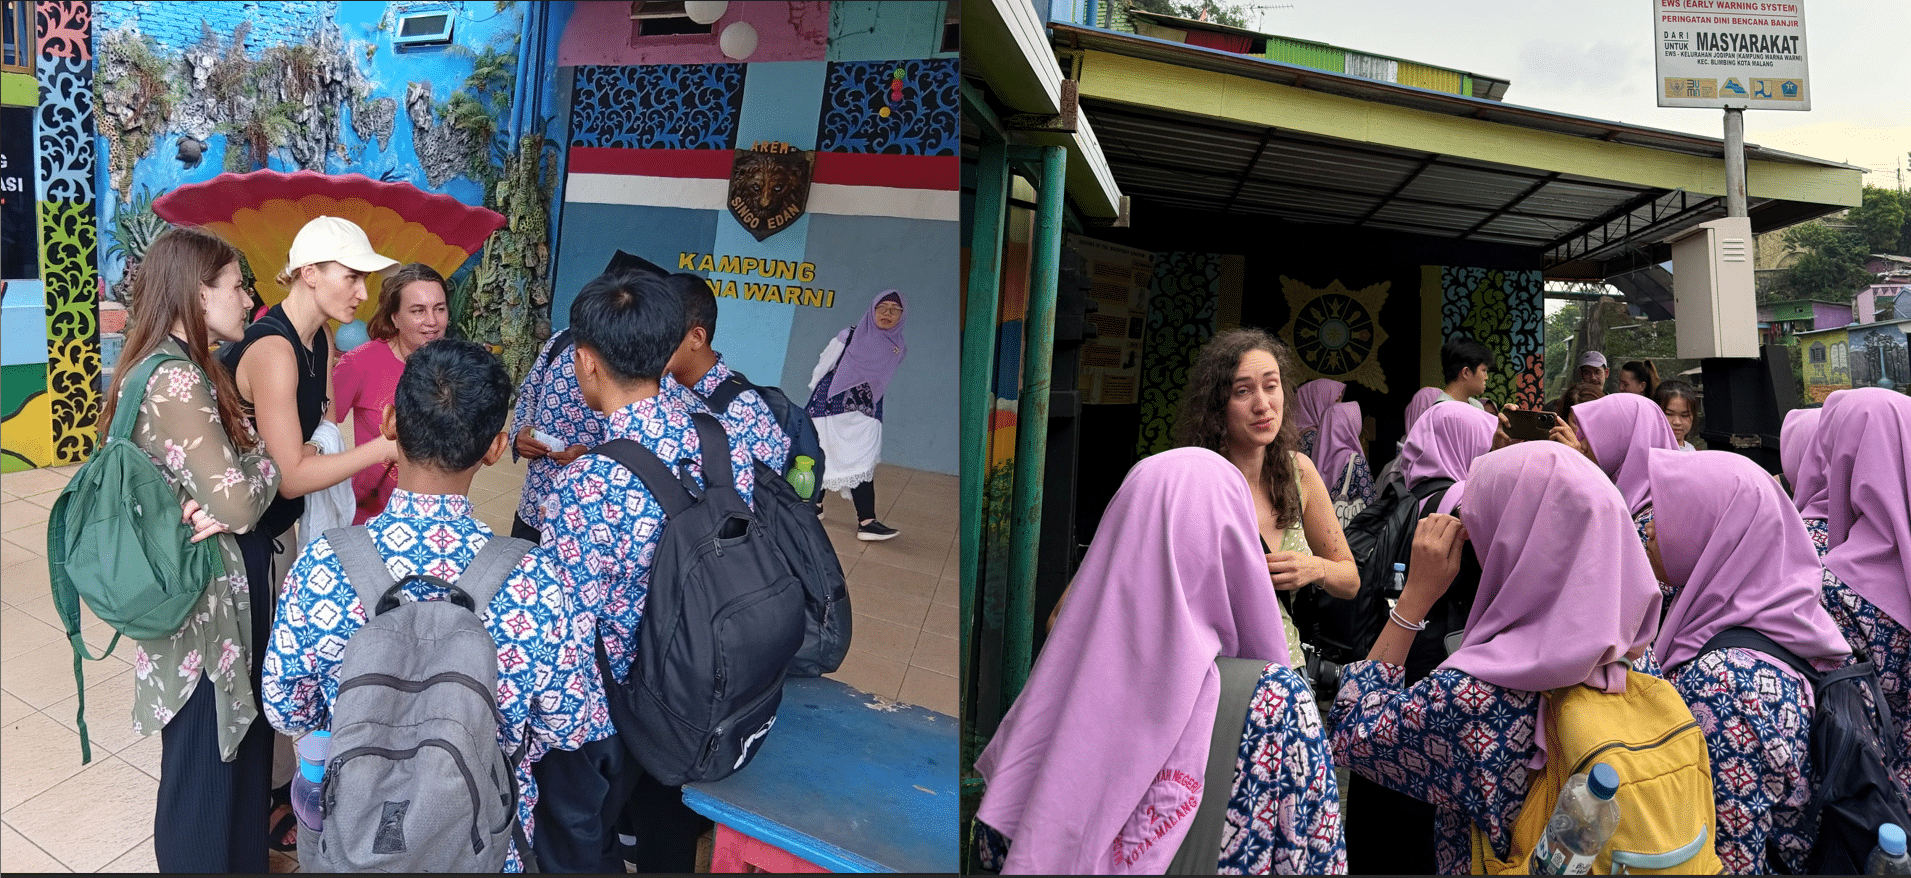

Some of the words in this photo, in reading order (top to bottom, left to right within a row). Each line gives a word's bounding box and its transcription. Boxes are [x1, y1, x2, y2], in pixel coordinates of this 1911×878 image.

[1683, 0, 1713, 9] (EARLY
[1716, 1, 1758, 10] WARNING
[1760, 3, 1798, 14] SYSTEM)
[1662, 15, 1711, 23] PERINGATAN
[1732, 18, 1769, 26] BENCANA
[1770, 19, 1799, 27] BANJIR
[1664, 31, 1689, 39] DARI
[1696, 31, 1799, 54] MASYARAKAT
[1664, 42, 1689, 50] UNTUK
[750, 140, 789, 155] AREM
[731, 196, 760, 229] SINGO
[767, 203, 800, 230] EDAN
[678, 252, 816, 283] KAMPUNG
[743, 283, 836, 308] WARNI
[1172, 769, 1202, 794] NEGERI
[1146, 805, 1161, 825] 2
